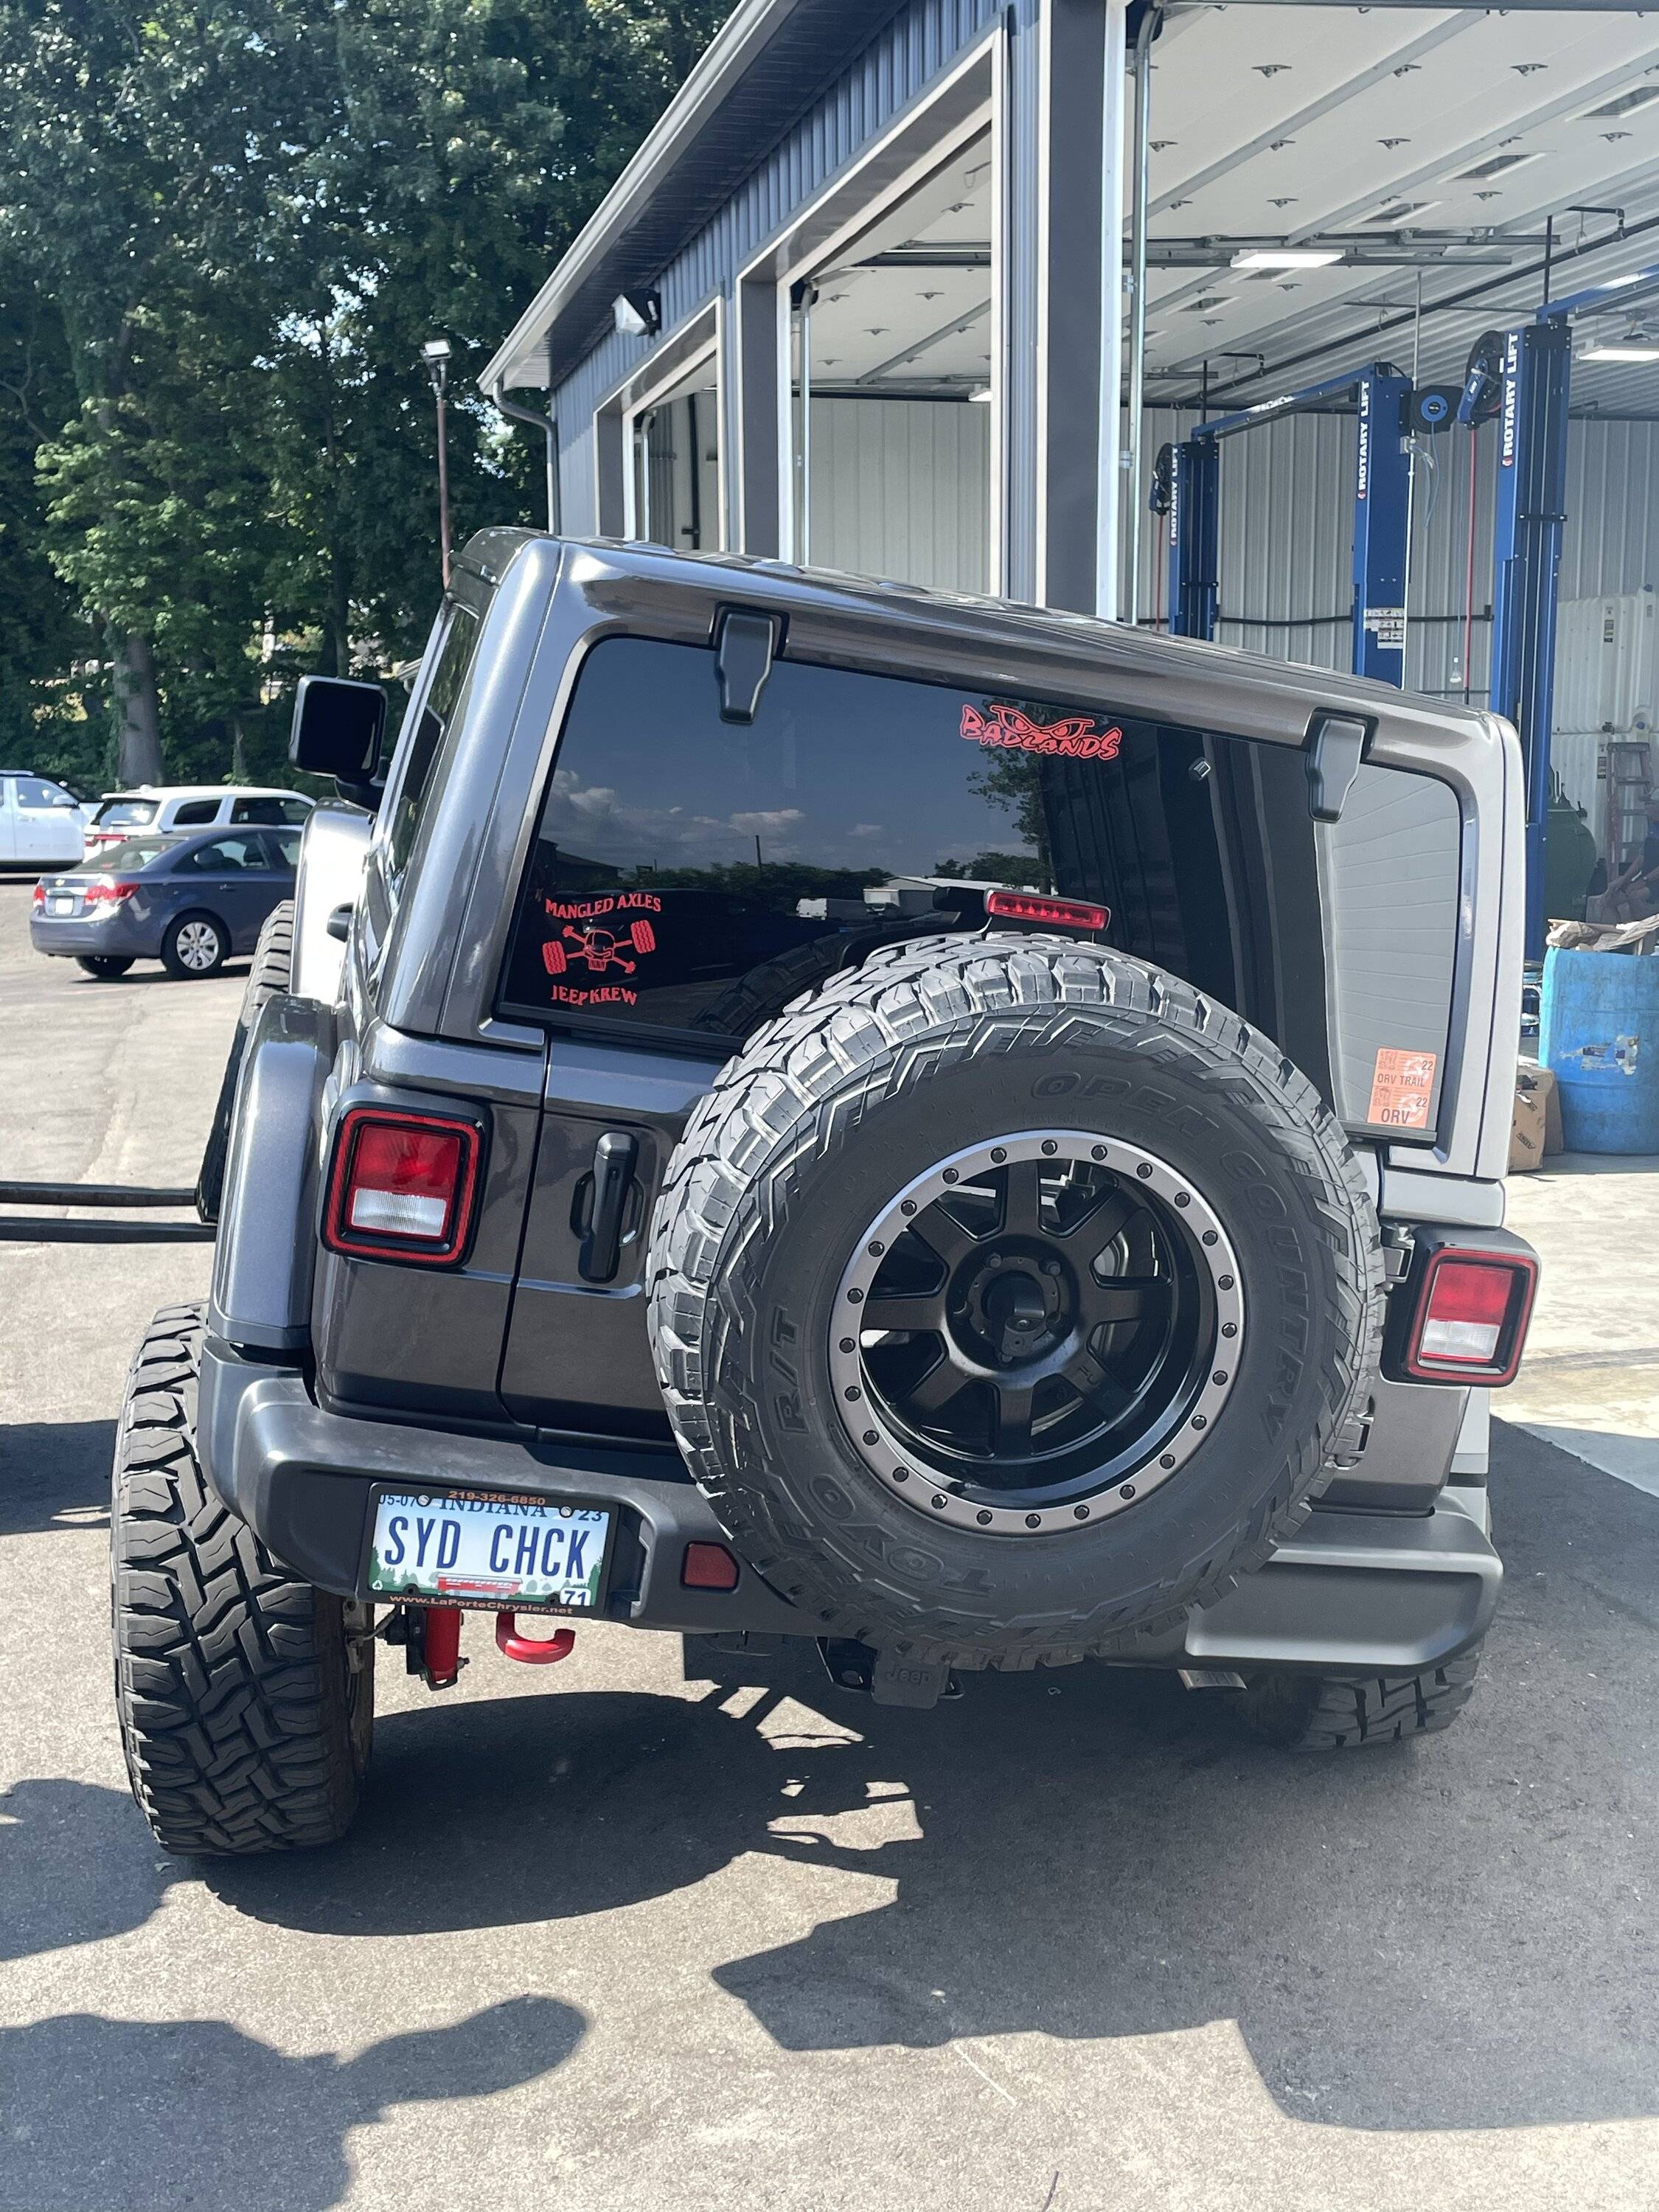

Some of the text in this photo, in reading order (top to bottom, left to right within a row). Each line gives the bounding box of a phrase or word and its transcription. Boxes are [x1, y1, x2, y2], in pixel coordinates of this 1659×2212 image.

[1503, 333, 1518, 456] ROTARY LIFT
[1358, 381, 1370, 490] ROTARY LIFT
[960, 704, 1122, 760] BADLANDS
[545, 893, 661, 919] MANGLED AXLES
[550, 985, 637, 1006] JEEP KREW
[1421, 1060, 1433, 1071] 22
[1377, 1074, 1425, 1087] ORV TRAIL
[1032, 1071, 1221, 1139] OPEN
[1416, 1097, 1427, 1107] 22
[1381, 1108, 1411, 1124] ORV
[1220, 1150, 1310, 1444] COUNTRY
[771, 1305, 810, 1434] R/T
[439, 1498, 549, 1517] INDIANA
[578, 1510, 602, 1522] 23
[448, 1491, 546, 1506] 219-326-6850
[384, 1516, 590, 1579] SYD CHCK
[811, 1475, 997, 1597] TOYO
[389, 1594, 574, 1615] www.LaPorteChrysler.net
[564, 1590, 587, 1606] 71
[885, 1664, 931, 1686] Jeep
